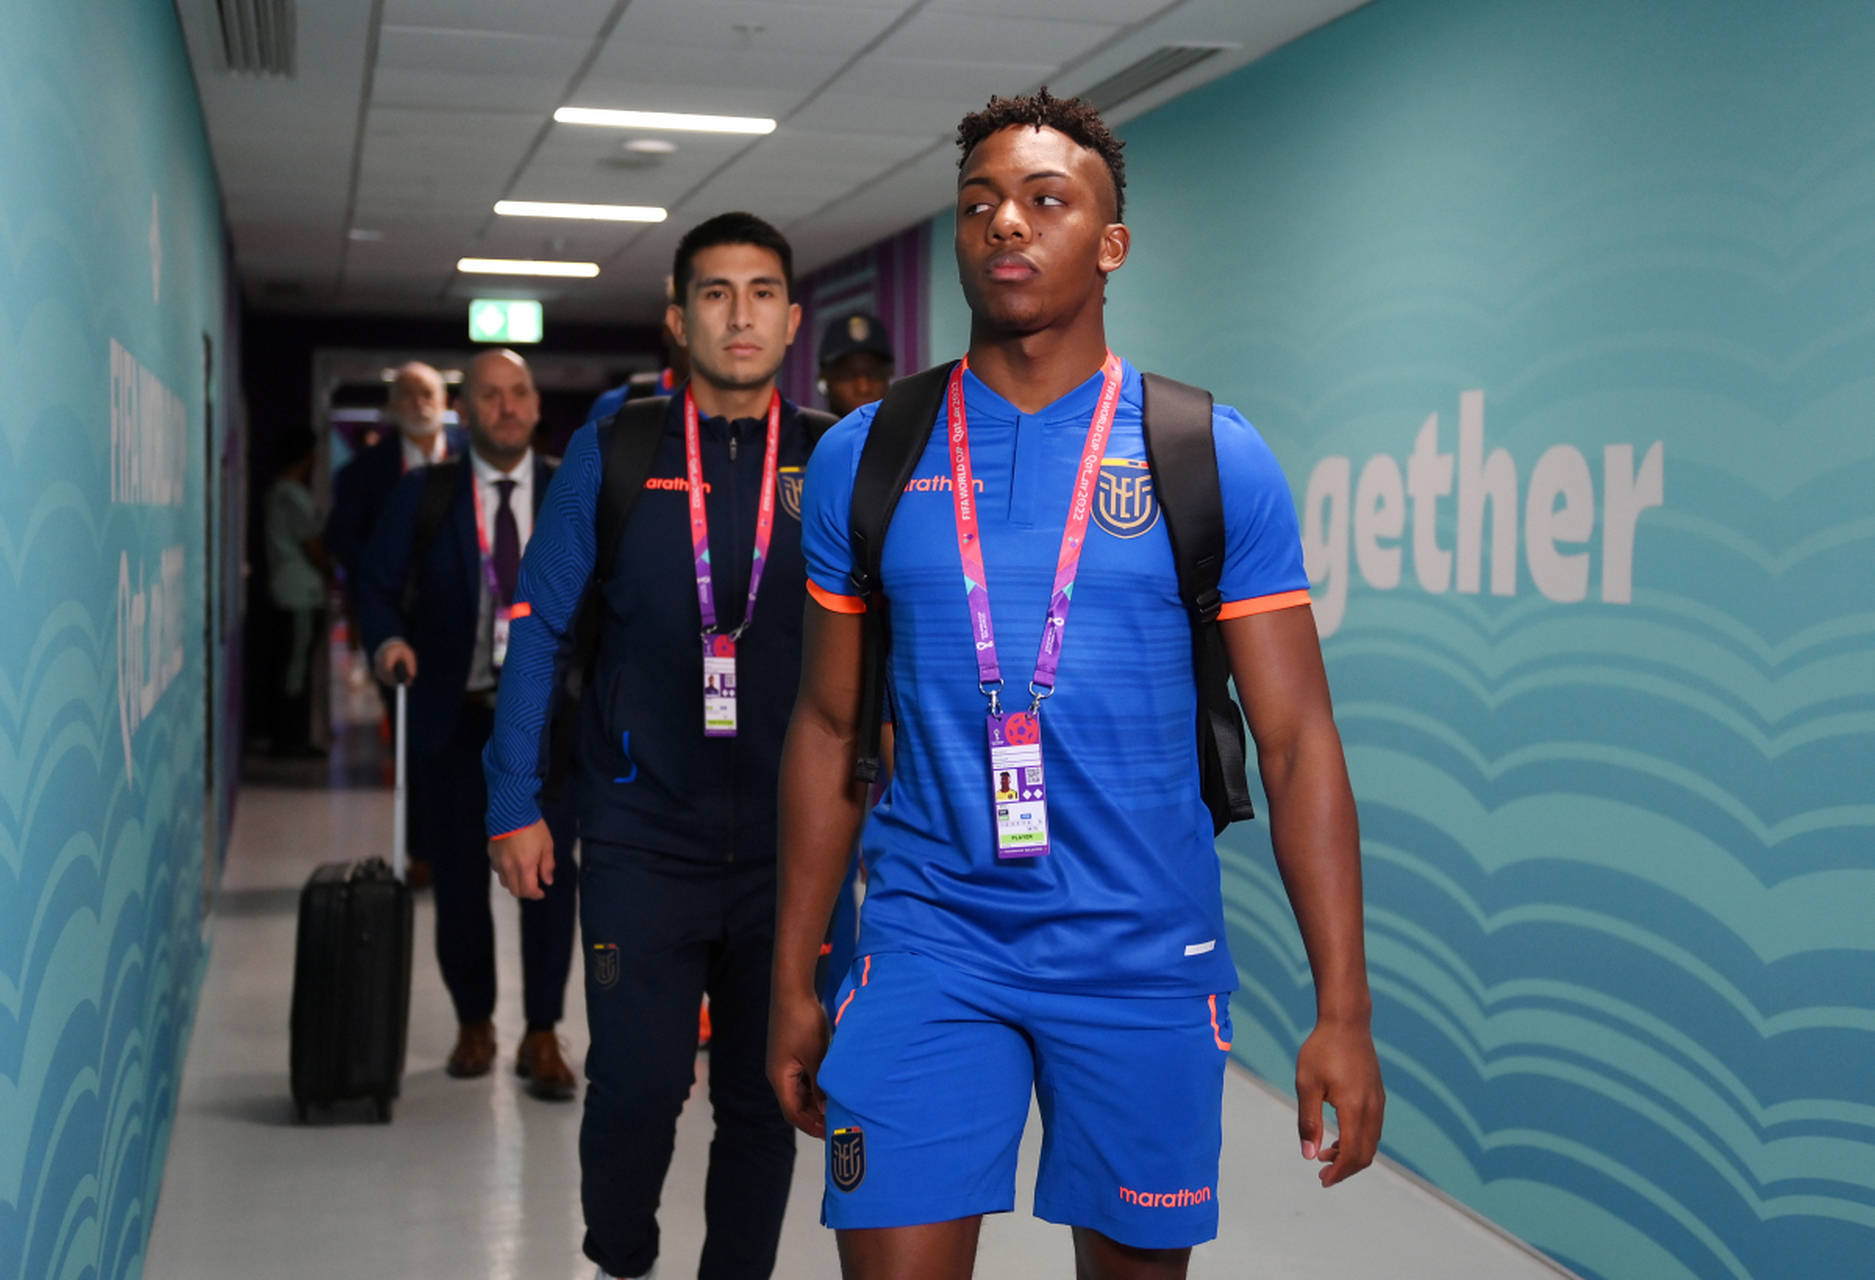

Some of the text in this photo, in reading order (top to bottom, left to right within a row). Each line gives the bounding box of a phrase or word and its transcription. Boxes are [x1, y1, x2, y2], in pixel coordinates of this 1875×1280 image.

[1105, 380, 1117, 401] FIFA
[645, 476, 712, 494] arathn
[904, 475, 985, 493] rathn
[957, 463, 969, 499] WORLD
[960, 498, 971, 520] FIFA
[1302, 389, 1664, 639] gether
[1119, 1186, 1211, 1208] marathon
